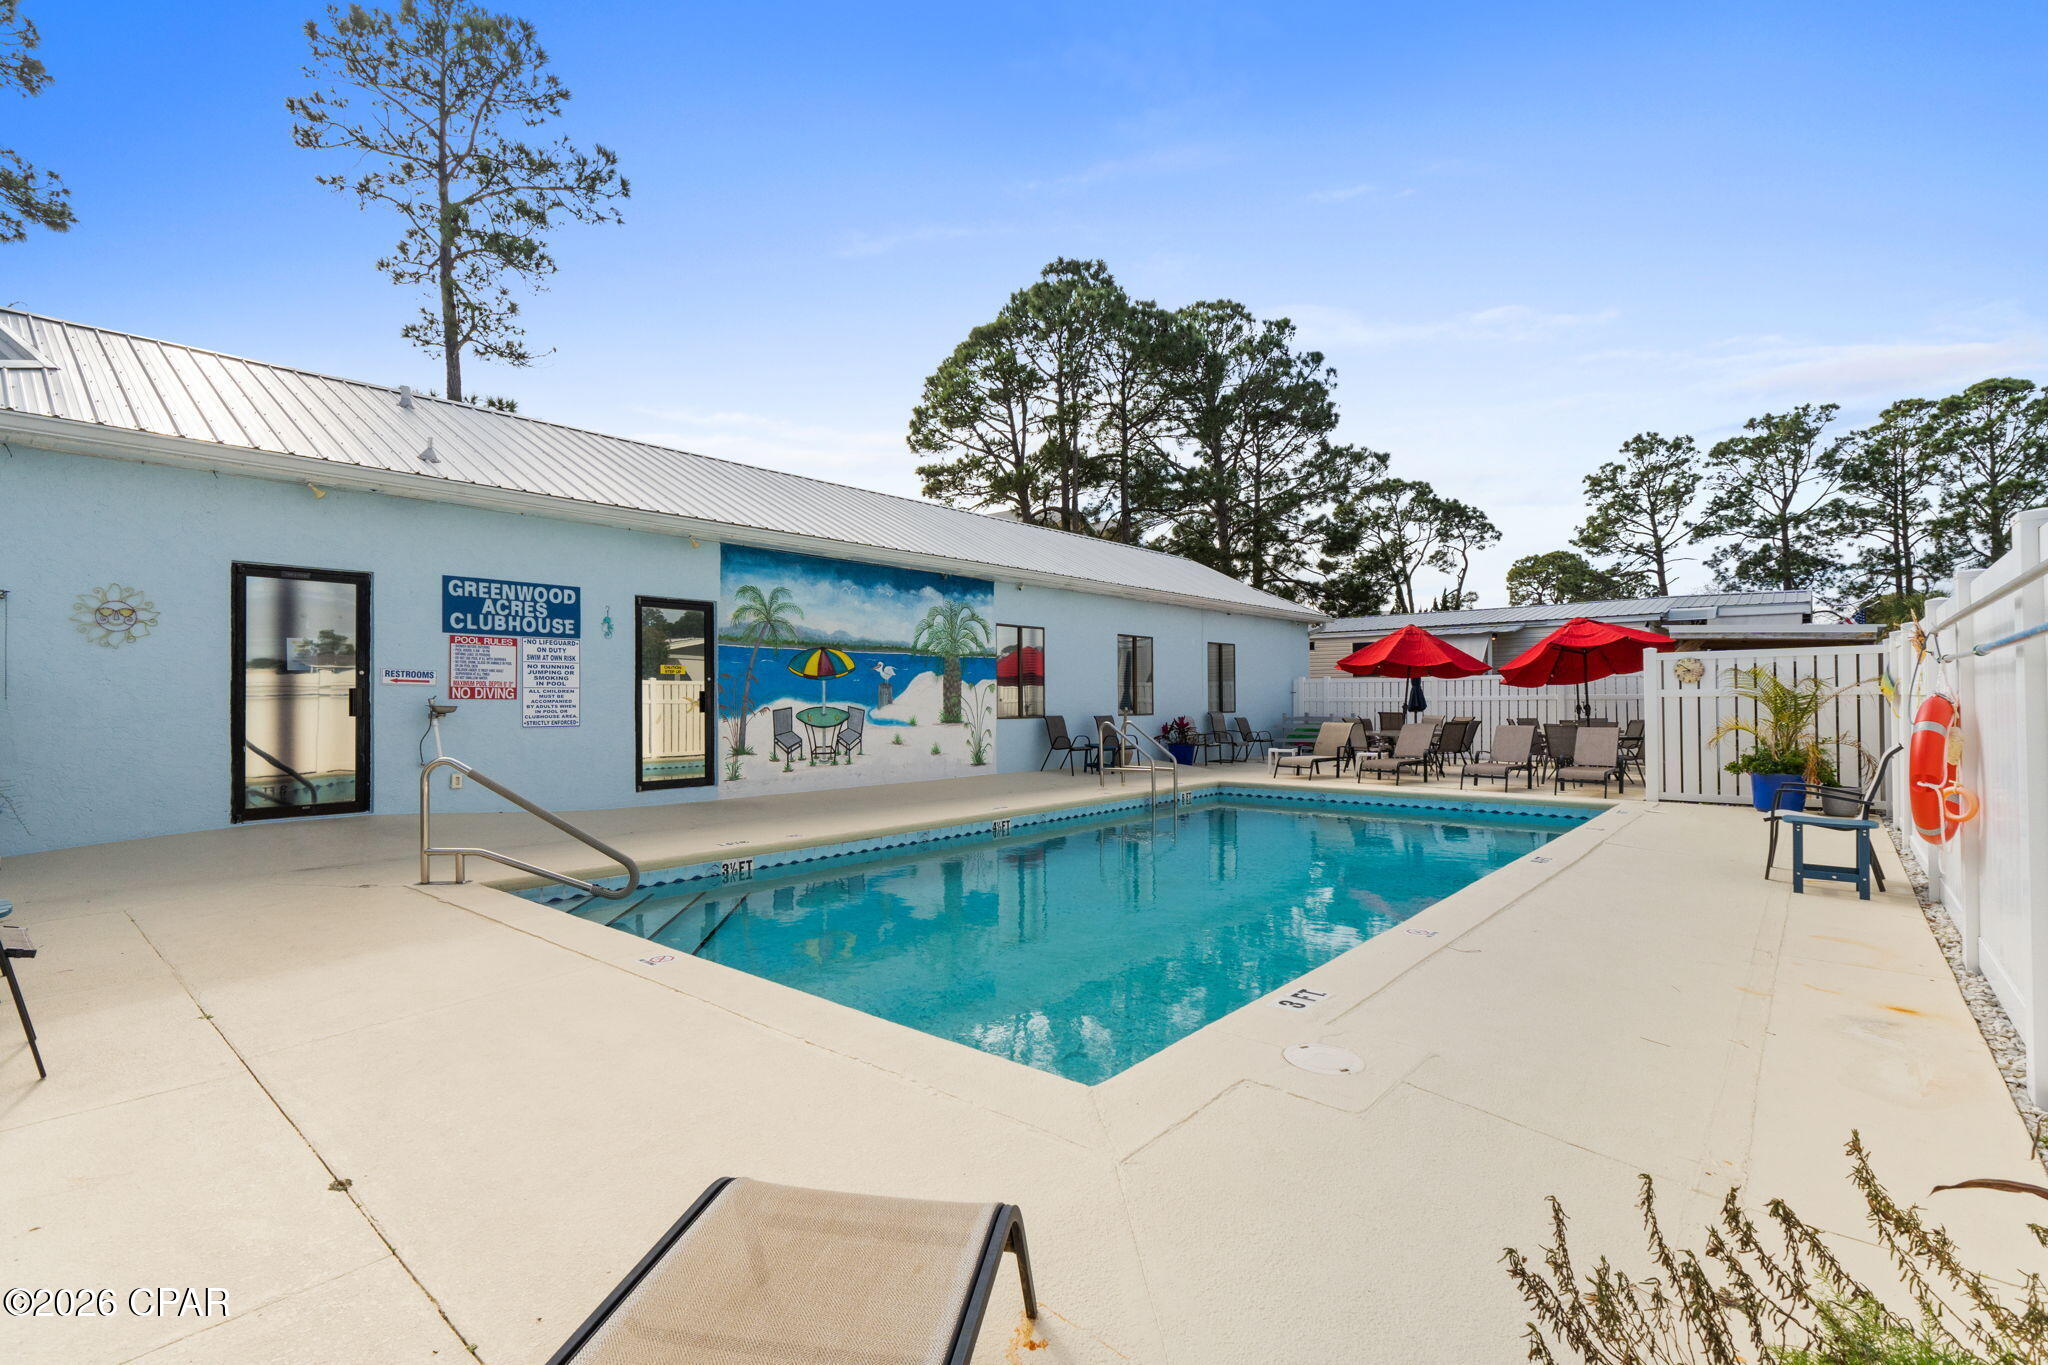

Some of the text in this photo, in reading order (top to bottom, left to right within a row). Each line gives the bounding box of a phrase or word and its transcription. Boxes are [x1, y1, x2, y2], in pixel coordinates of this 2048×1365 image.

[448, 579, 576, 605] GREENWOOD
[481, 598, 548, 618] ACRES
[450, 612, 575, 635] CLUBHOUSE
[454, 636, 513, 646] POOL RULES
[384, 669, 435, 679] RESTROOMS
[451, 687, 515, 699] NO DIVING
[1290, 988, 1328, 1002] FT
